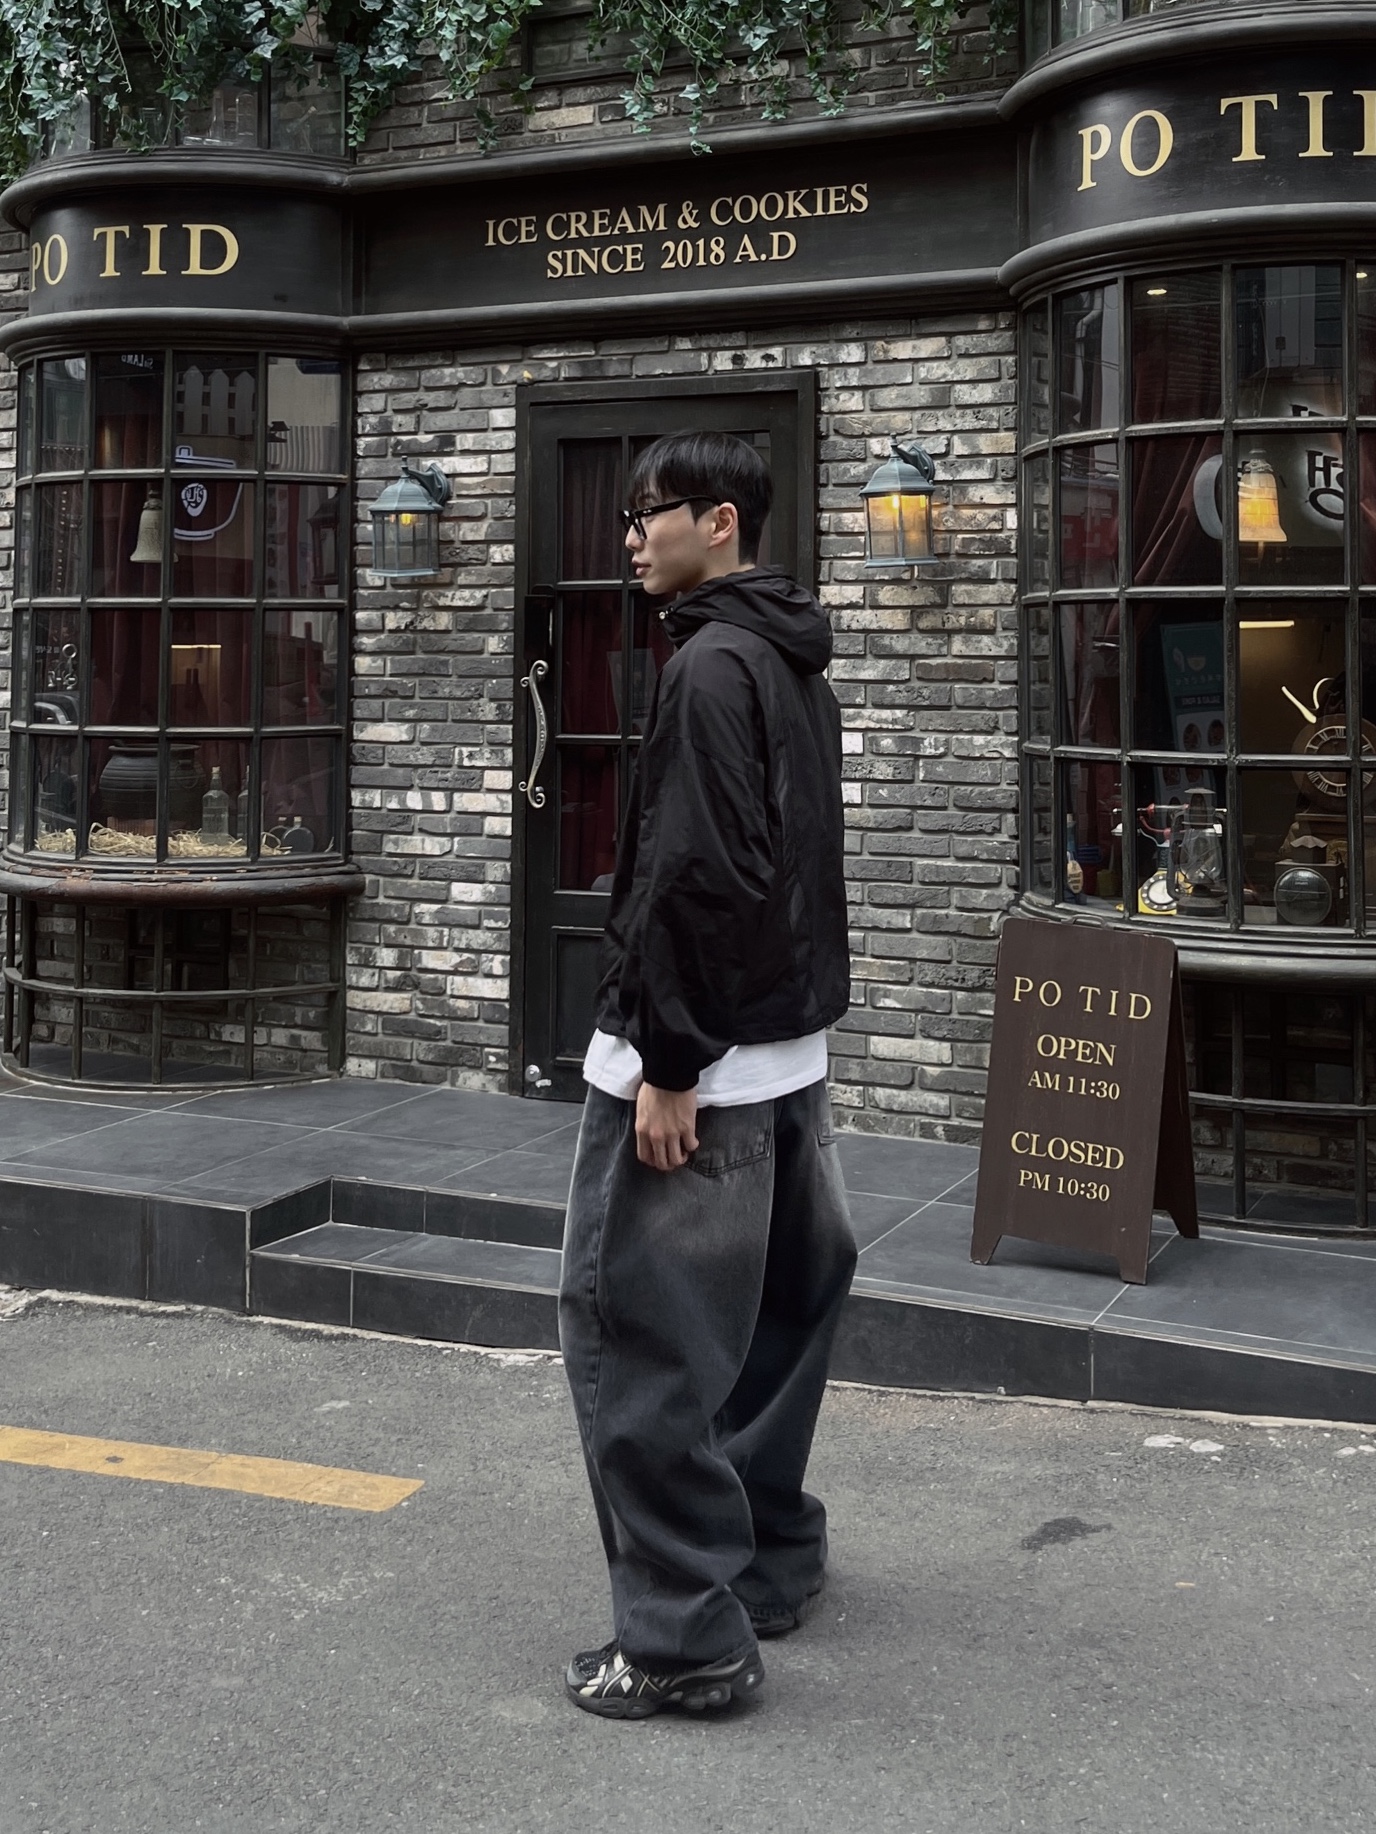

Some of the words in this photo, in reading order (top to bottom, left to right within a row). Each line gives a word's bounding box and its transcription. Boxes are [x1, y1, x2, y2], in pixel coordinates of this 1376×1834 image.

[1077, 110, 1174, 191] PO
[485, 217, 538, 246] ICE
[545, 203, 667, 241] CREAM
[677, 202, 700, 229] &
[710, 184, 869, 226] COOKIES
[31, 234, 69, 292] PO
[93, 223, 240, 277] TID
[546, 243, 645, 278] SINCE
[661, 237, 727, 269] 2018
[735, 230, 797, 262] A.D
[1012, 975, 1062, 1007] PO
[1078, 985, 1152, 1020] TID
[1036, 1033, 1117, 1067] OPEN
[1028, 1070, 1061, 1092] AM
[1066, 1075, 1121, 1101] 11:30
[1010, 1130, 1125, 1170] CLOSED
[1018, 1169, 1051, 1192] PM
[1056, 1176, 1111, 1202] 10:30
